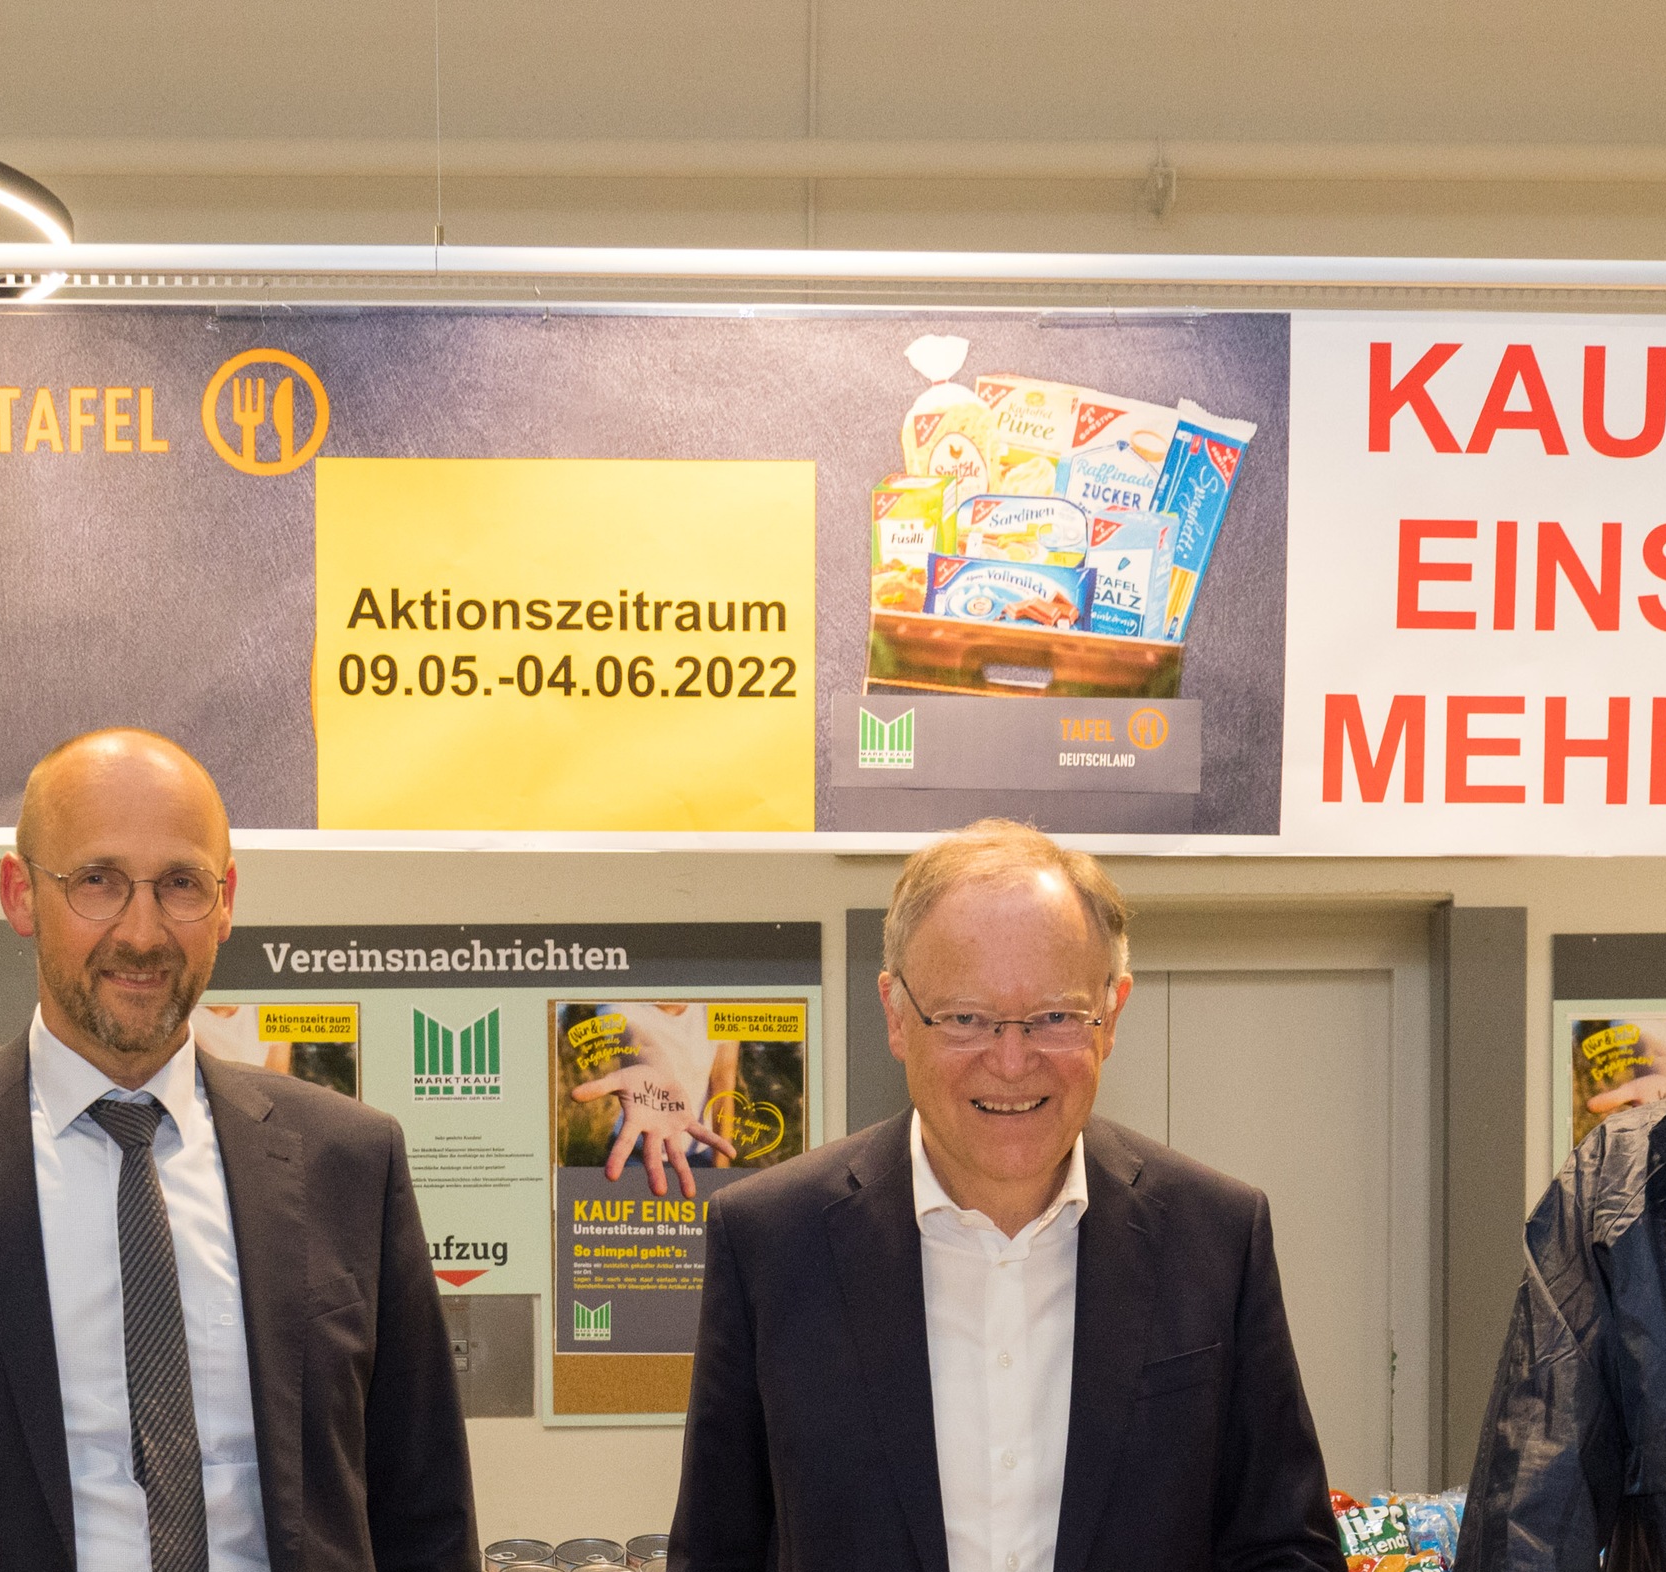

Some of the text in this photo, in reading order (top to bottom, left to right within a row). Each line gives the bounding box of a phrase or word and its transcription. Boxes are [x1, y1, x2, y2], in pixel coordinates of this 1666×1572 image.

[1077, 459, 1153, 489] Raffinade
[1083, 483, 1141, 510] ZUCKER
[990, 507, 1054, 528] Sardinen
[891, 533, 924, 544] Fusilli
[987, 569, 1047, 599] Vollmilch
[348, 587, 787, 632] Aktionszeitraum
[337, 653, 797, 698] 09.05.-04.06.2022
[1060, 719, 1114, 741] TAFEL
[1059, 753, 1135, 767] DEUTSCHLAND
[262, 940, 630, 974] Vereinsnachrichten
[266, 1014, 350, 1023] Aktionszeitraum
[714, 1013, 798, 1023] Aktionszeitraum
[749, 1024, 798, 1032] 04.06.2022
[301, 1025, 350, 1033] 04.06.2022
[644, 1081, 669, 1100] WIR
[633, 1092, 685, 1112] HELFEN
[574, 1200, 635, 1222] KAUF
[642, 1200, 695, 1222] EINS
[573, 1223, 703, 1235] Unterstützen Sie Ihre
[427, 1235, 507, 1266] ufzug
[574, 1245, 637, 1259] So simpel
